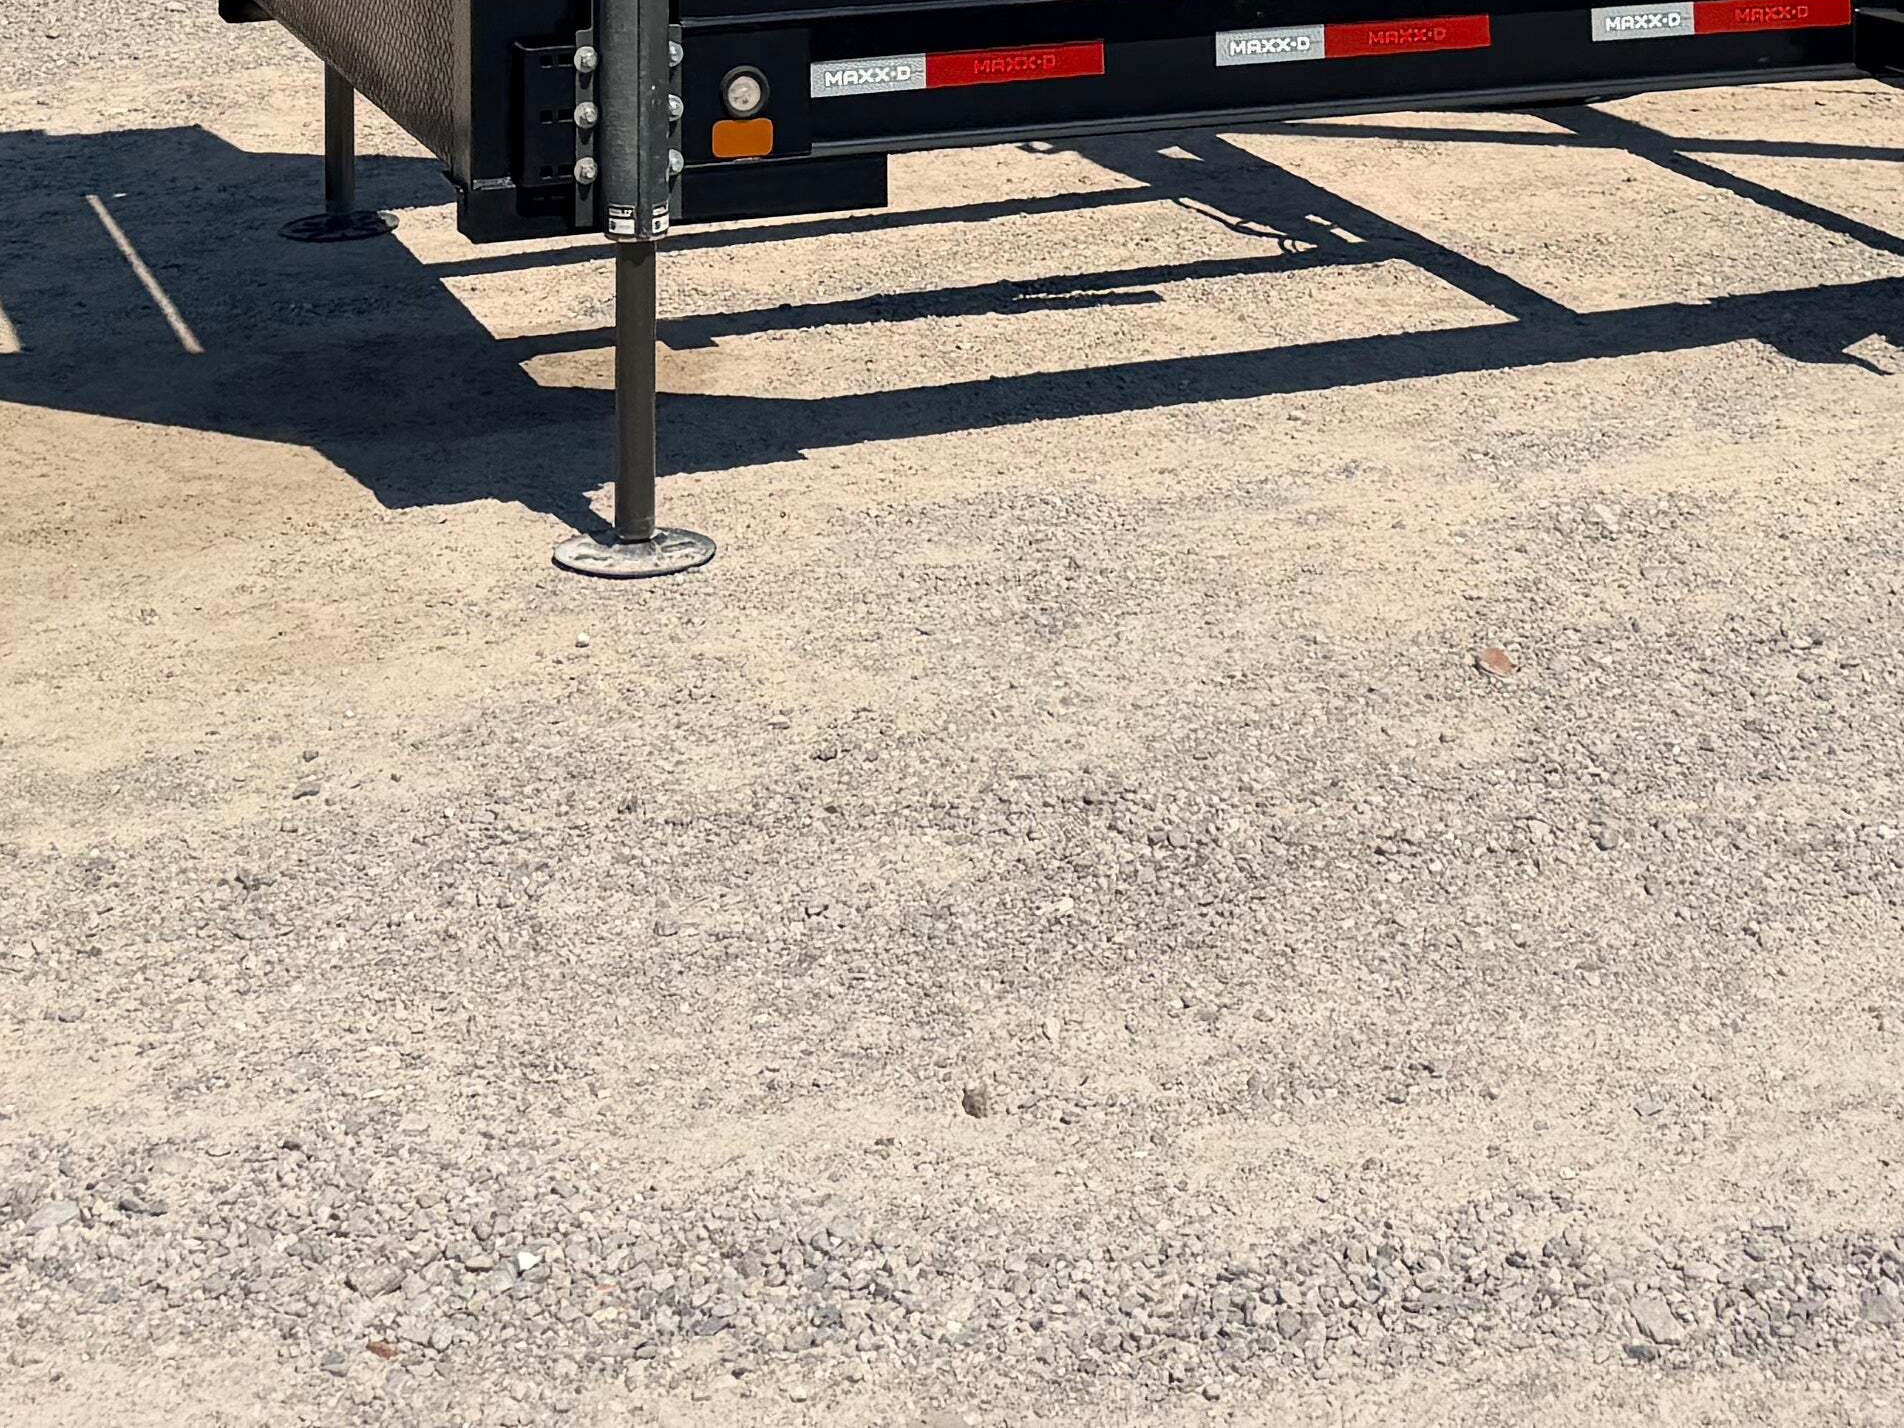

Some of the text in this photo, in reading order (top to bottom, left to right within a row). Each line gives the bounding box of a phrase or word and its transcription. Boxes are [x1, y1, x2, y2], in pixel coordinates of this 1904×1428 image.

[1604, 12, 1682, 32] MAXX-D
[1228, 36, 1311, 56] MAXX-D
[823, 66, 911, 89] MAXX-D
